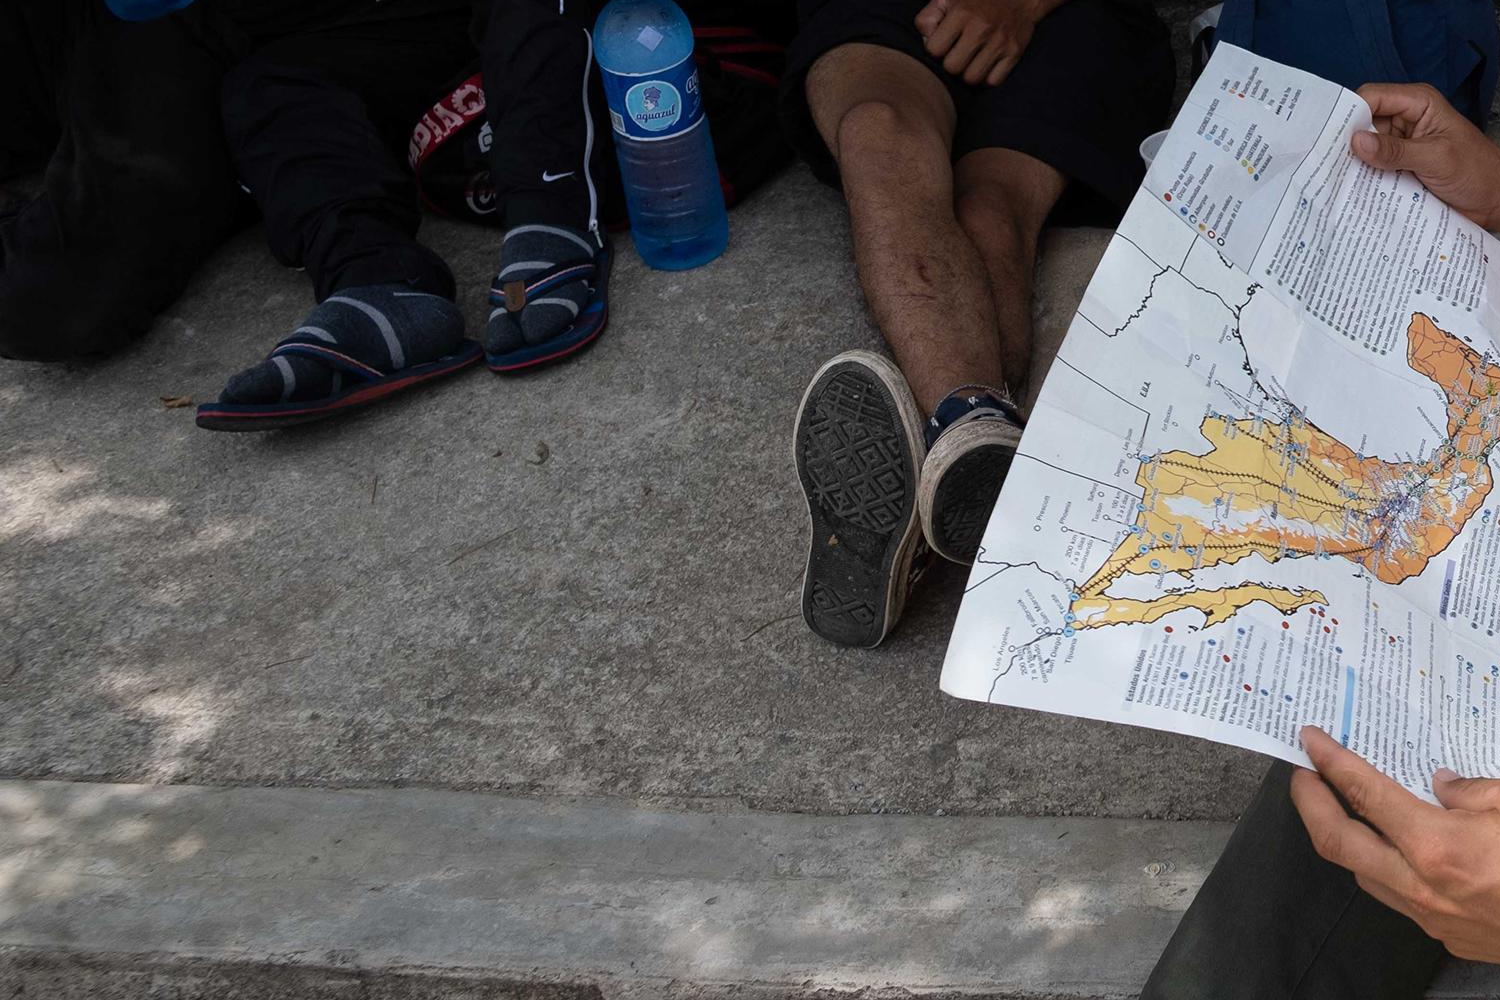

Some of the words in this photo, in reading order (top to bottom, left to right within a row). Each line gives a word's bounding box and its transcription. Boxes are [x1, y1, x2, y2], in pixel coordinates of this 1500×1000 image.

[1065, 638, 1078, 664] Tijuana
[993, 660, 1002, 671] Los
[1125, 672, 1139, 702] Estados
[1134, 648, 1146, 672] Unidos
